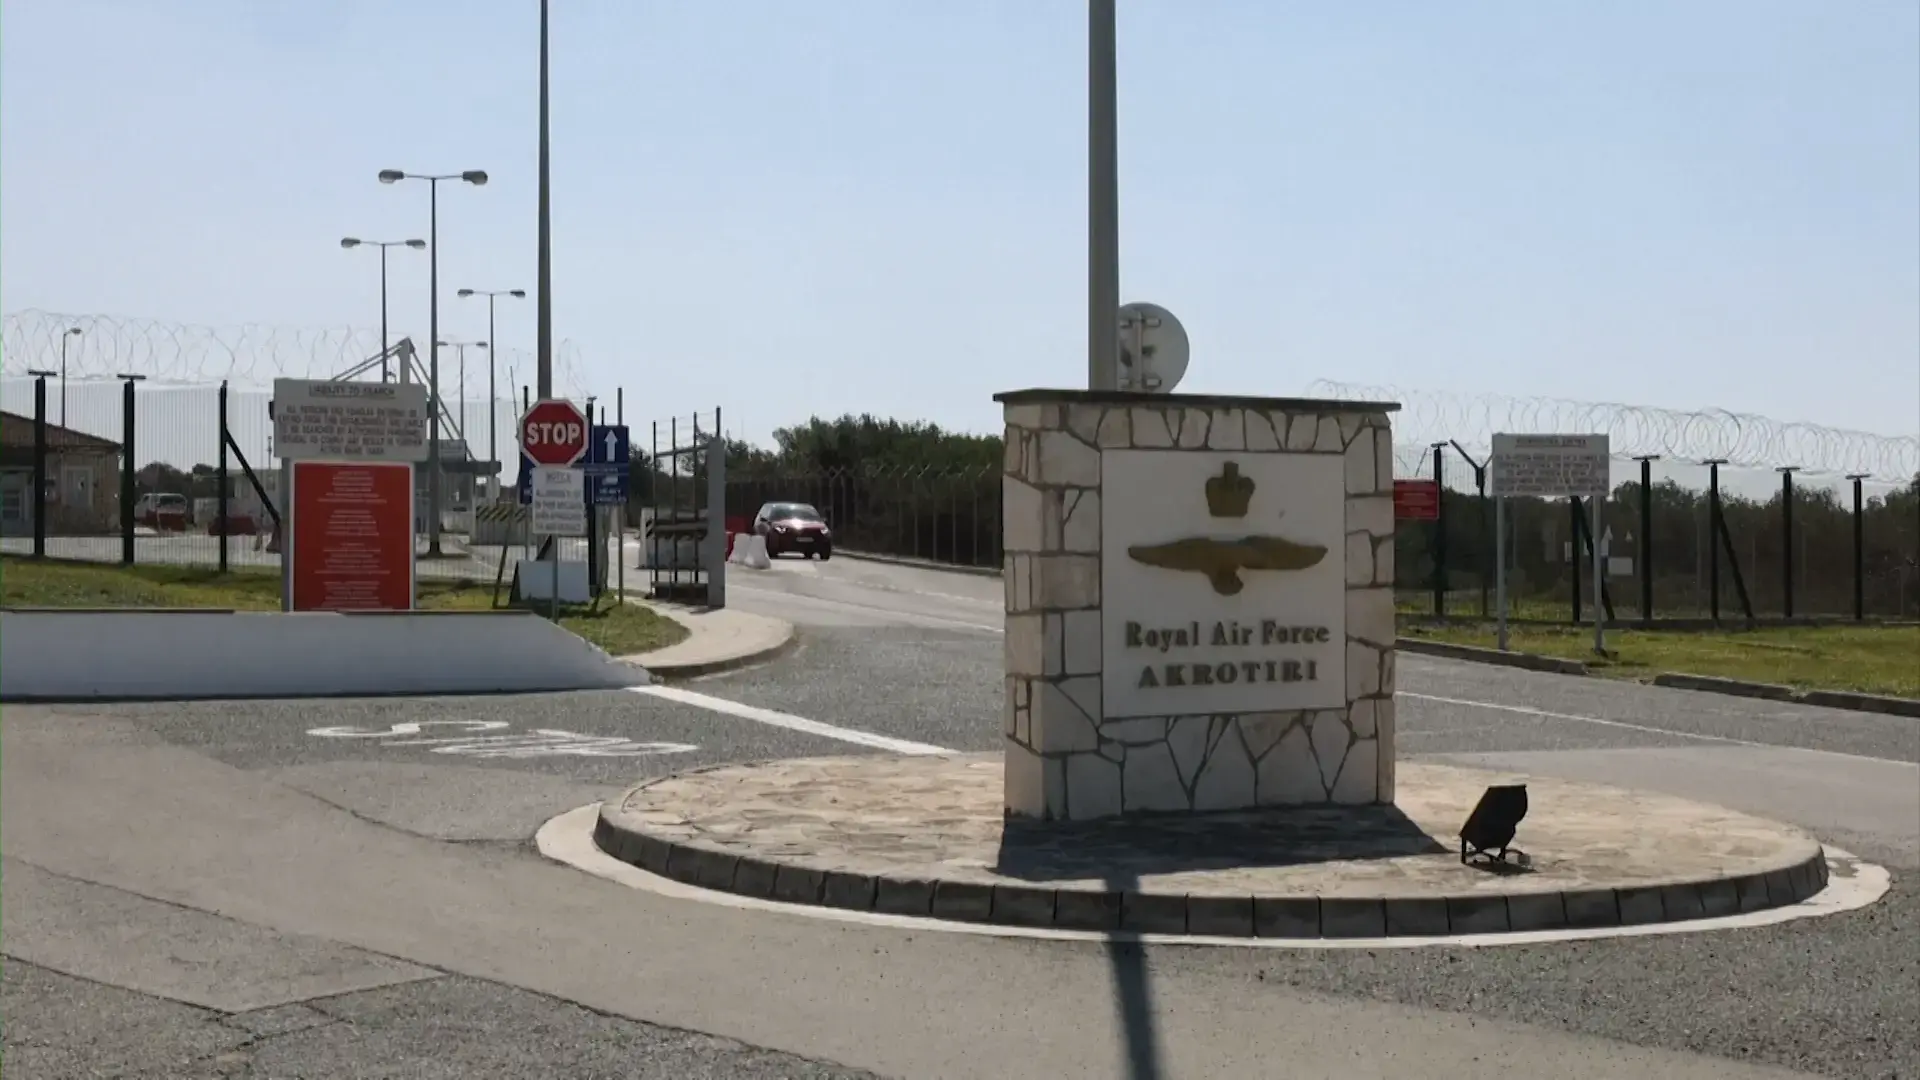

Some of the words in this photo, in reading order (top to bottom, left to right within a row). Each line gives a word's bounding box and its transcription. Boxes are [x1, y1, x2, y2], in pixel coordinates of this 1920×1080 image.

[527, 422, 581, 446] STOP
[1126, 620, 1200, 653] Royal
[1210, 620, 1254, 646] Air
[1261, 618, 1331, 646] Force
[1138, 659, 1318, 689] AKROTIRI
